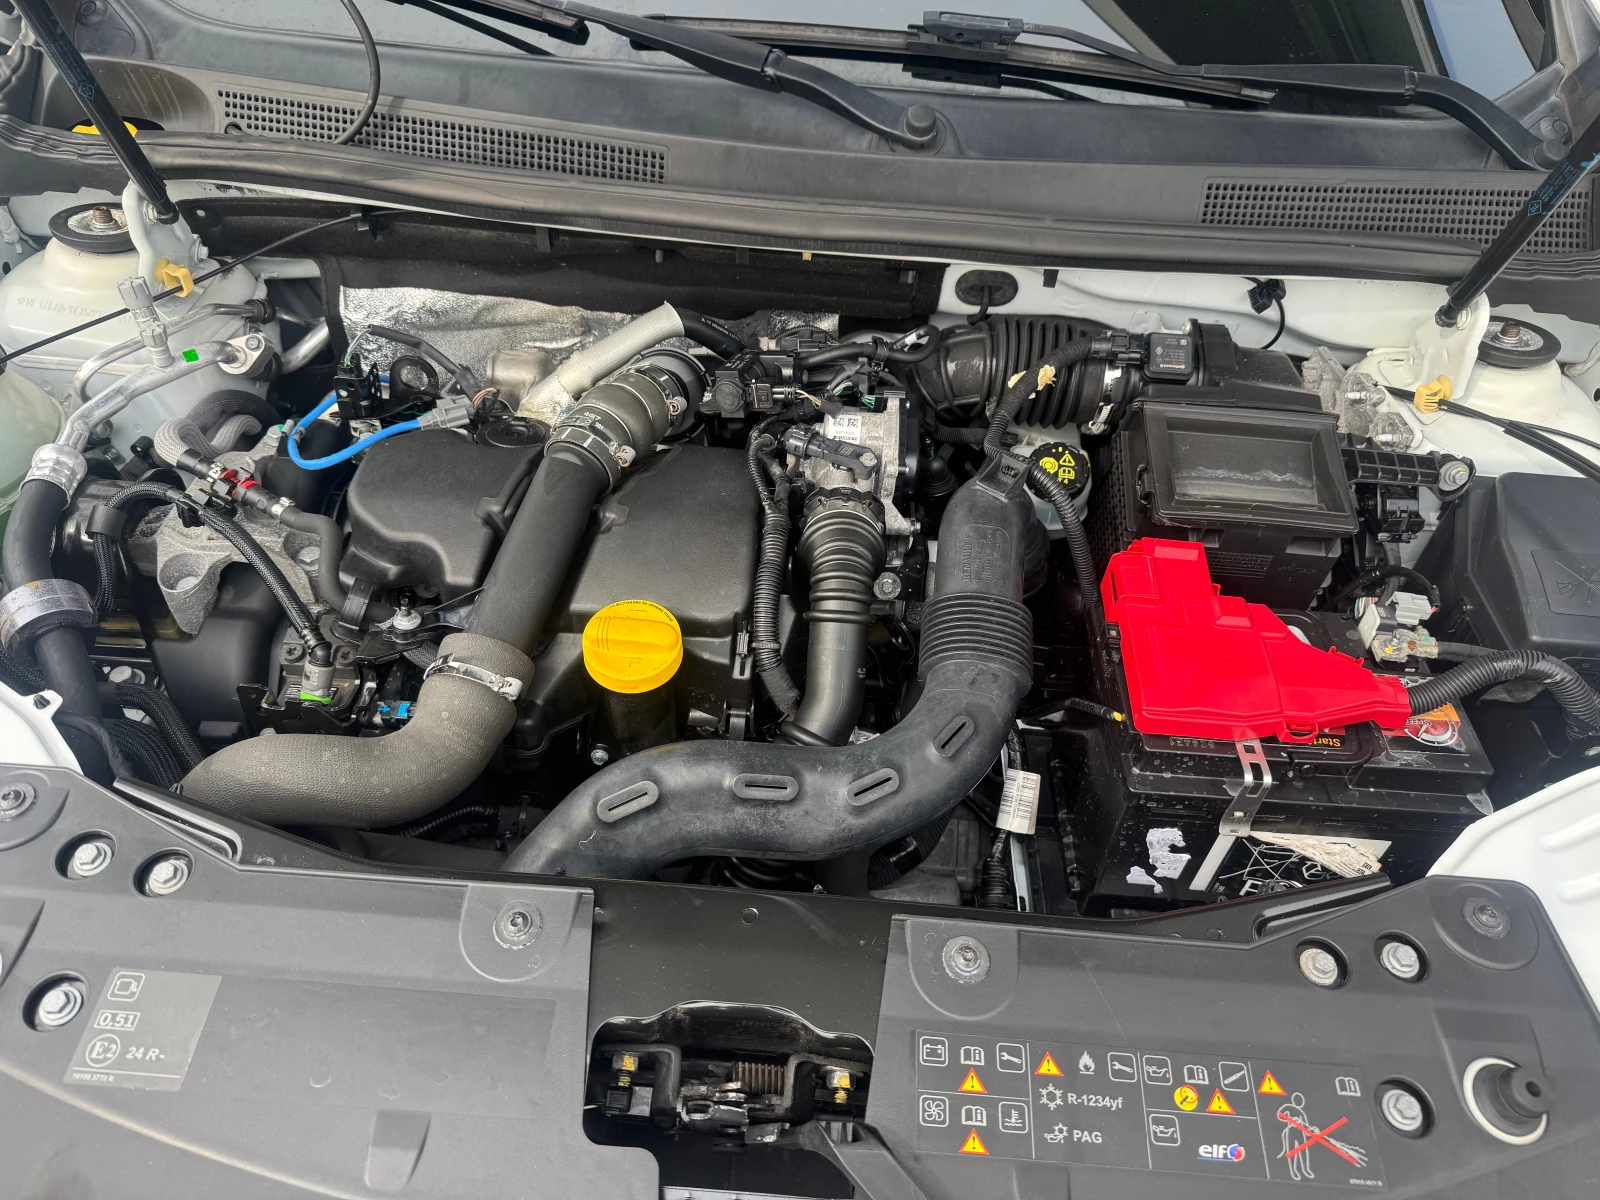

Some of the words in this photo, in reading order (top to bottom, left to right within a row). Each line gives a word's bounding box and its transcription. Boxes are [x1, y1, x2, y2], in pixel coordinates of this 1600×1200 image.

[99, 1012, 136, 1029] 0,51
[89, 1040, 117, 1060] E2
[125, 1046, 144, 1060] 24
[1067, 1092, 1123, 1110] R-1234yf
[1073, 1129, 1103, 1143] PAG
[1198, 1144, 1228, 1158] elf
